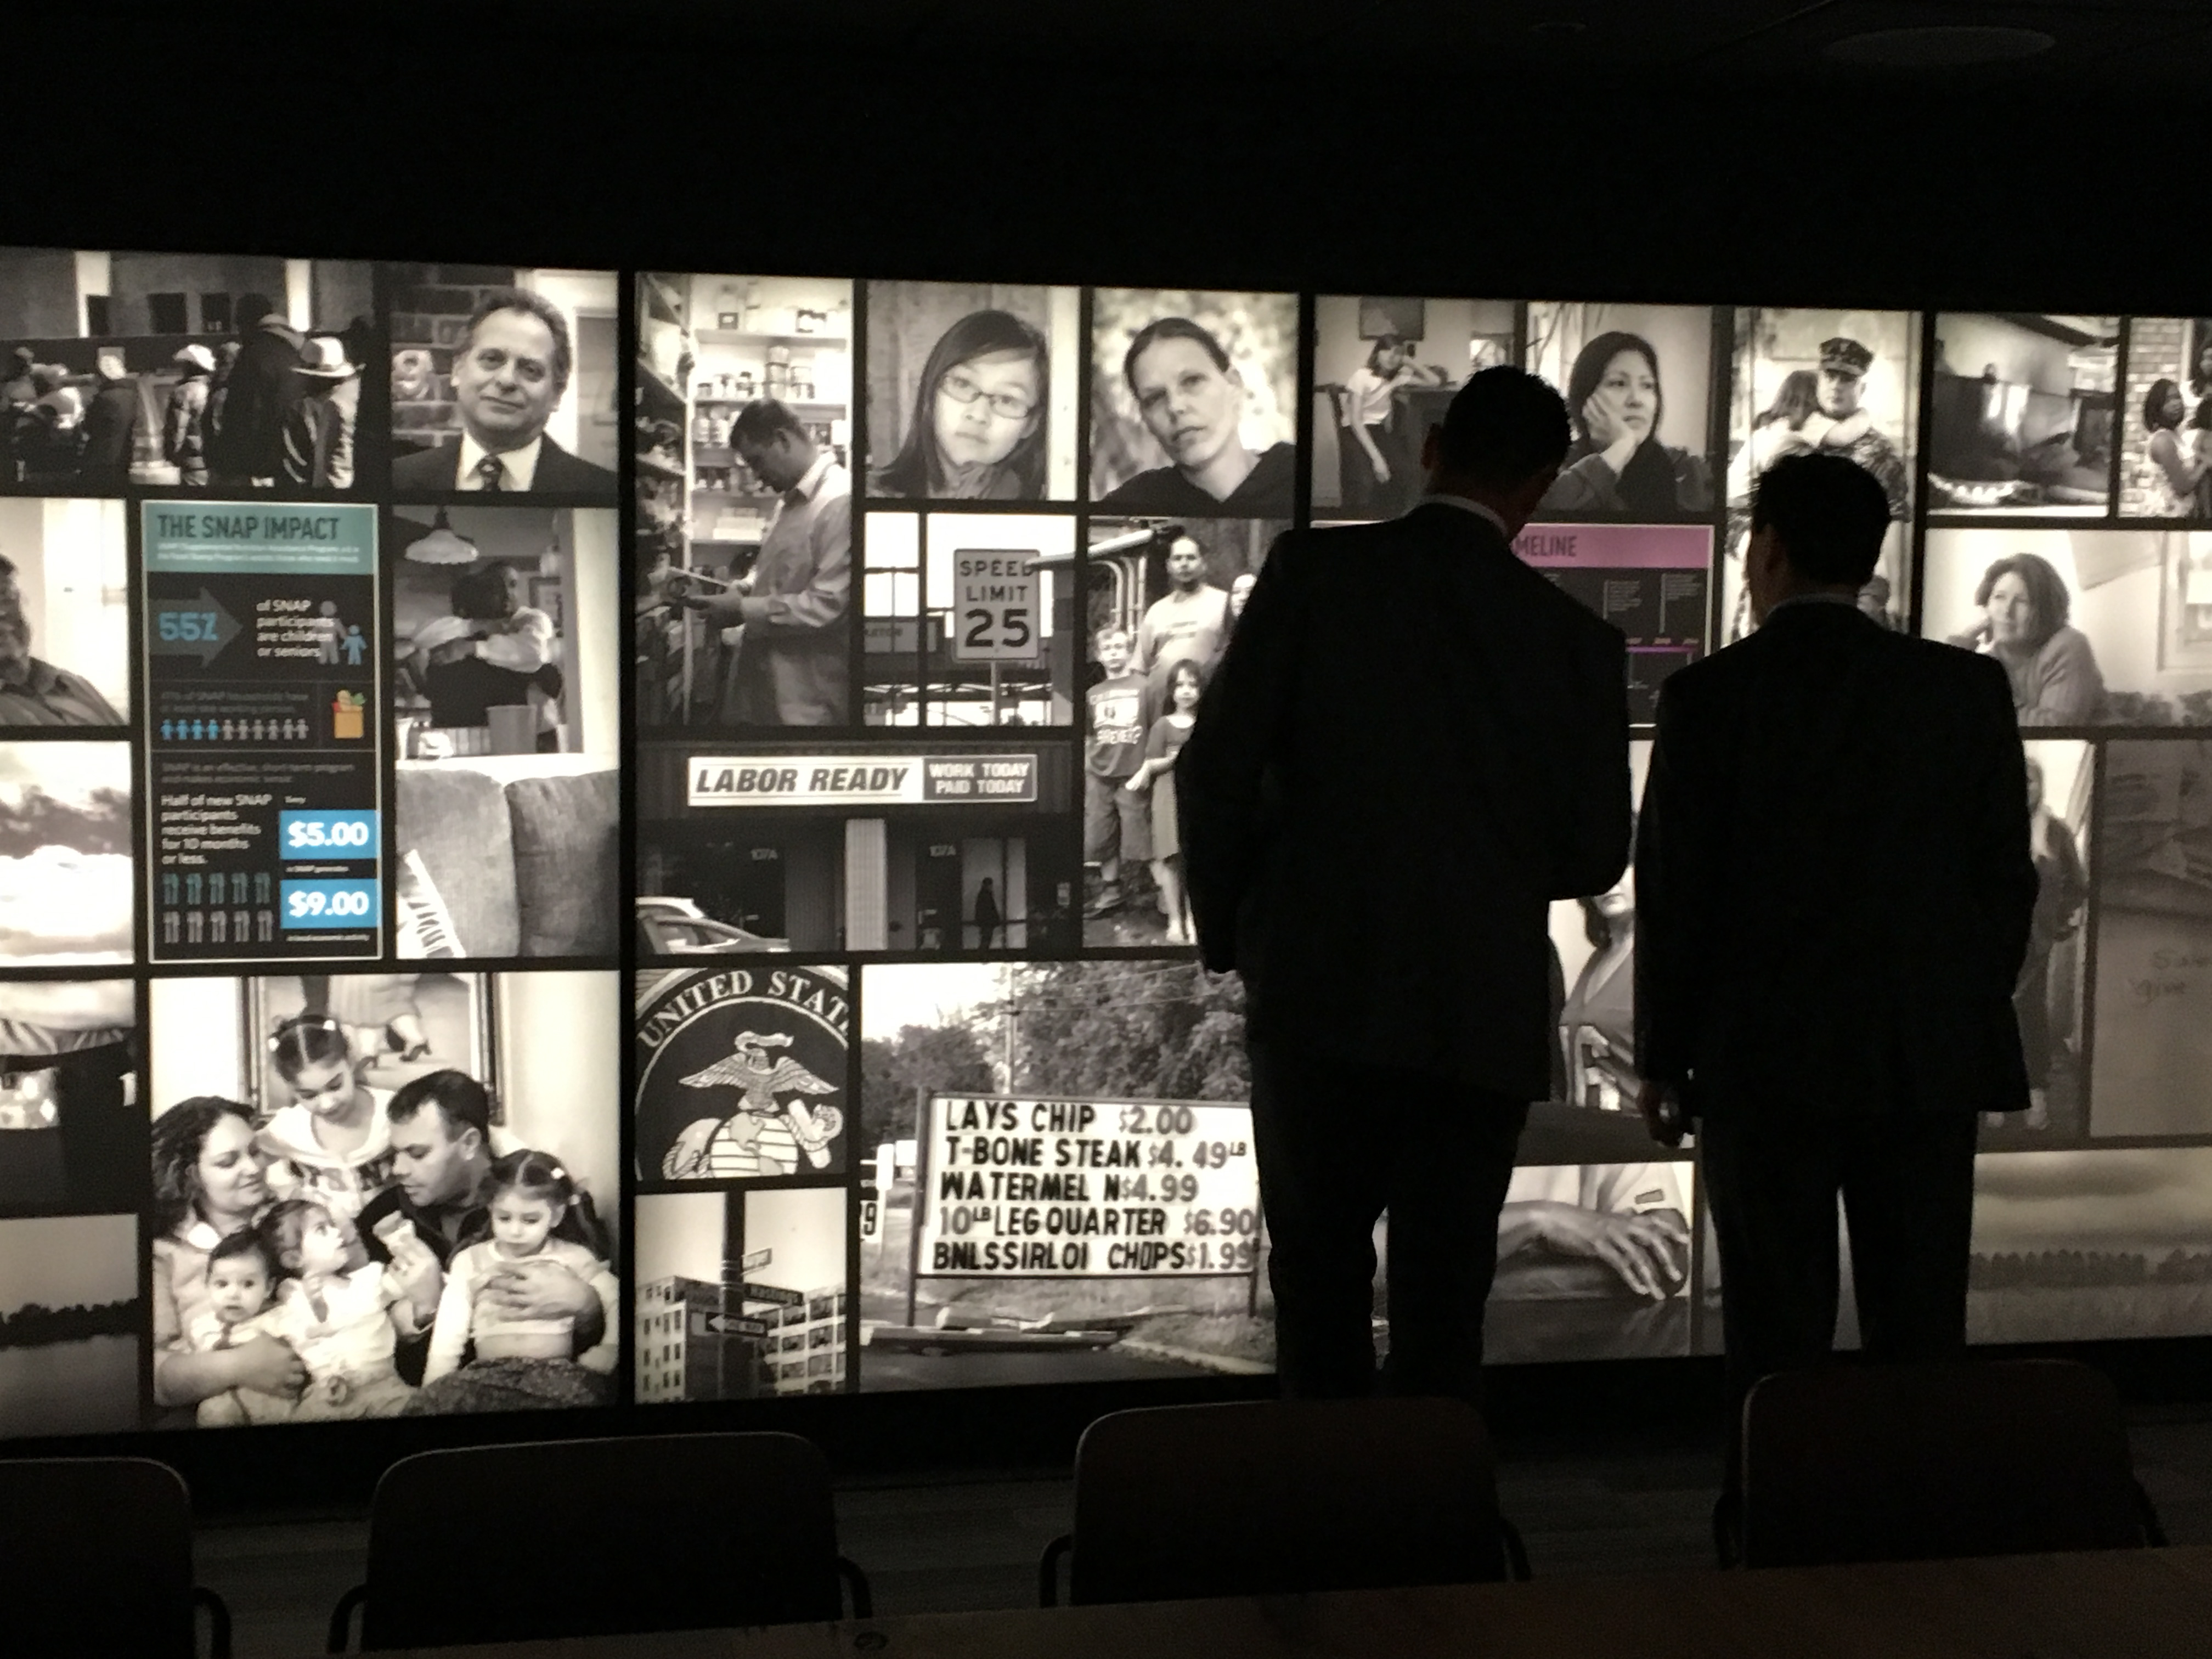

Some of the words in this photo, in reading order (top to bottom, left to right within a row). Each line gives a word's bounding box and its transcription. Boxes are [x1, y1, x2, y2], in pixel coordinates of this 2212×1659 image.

[157, 515, 195, 538] THE
[202, 516, 258, 539] SNAP
[264, 517, 340, 540] IMPACT
[966, 585, 1028, 601] LIMIT
[966, 608, 1029, 647] 25
[696, 768, 798, 793] LABOR
[809, 768, 909, 792] READY
[929, 763, 975, 777] WORK
[981, 763, 1030, 777] TODAY
[935, 780, 970, 794] PAID
[977, 779, 1024, 794] TODAY
[288, 820, 369, 848] $5.00
[288, 890, 369, 918] $9.00
[636, 970, 753, 1048] UNITED
[946, 1101, 1018, 1131] LAYS
[1031, 1103, 1096, 1132] CHIP
[1119, 1105, 1195, 1135] $2.00
[946, 1136, 1043, 1166] T-BONE
[1054, 1138, 1141, 1167] STEAK
[940, 1171, 1090, 1201] WATERMEL
[1183, 1208, 1257, 1237] $6.90
